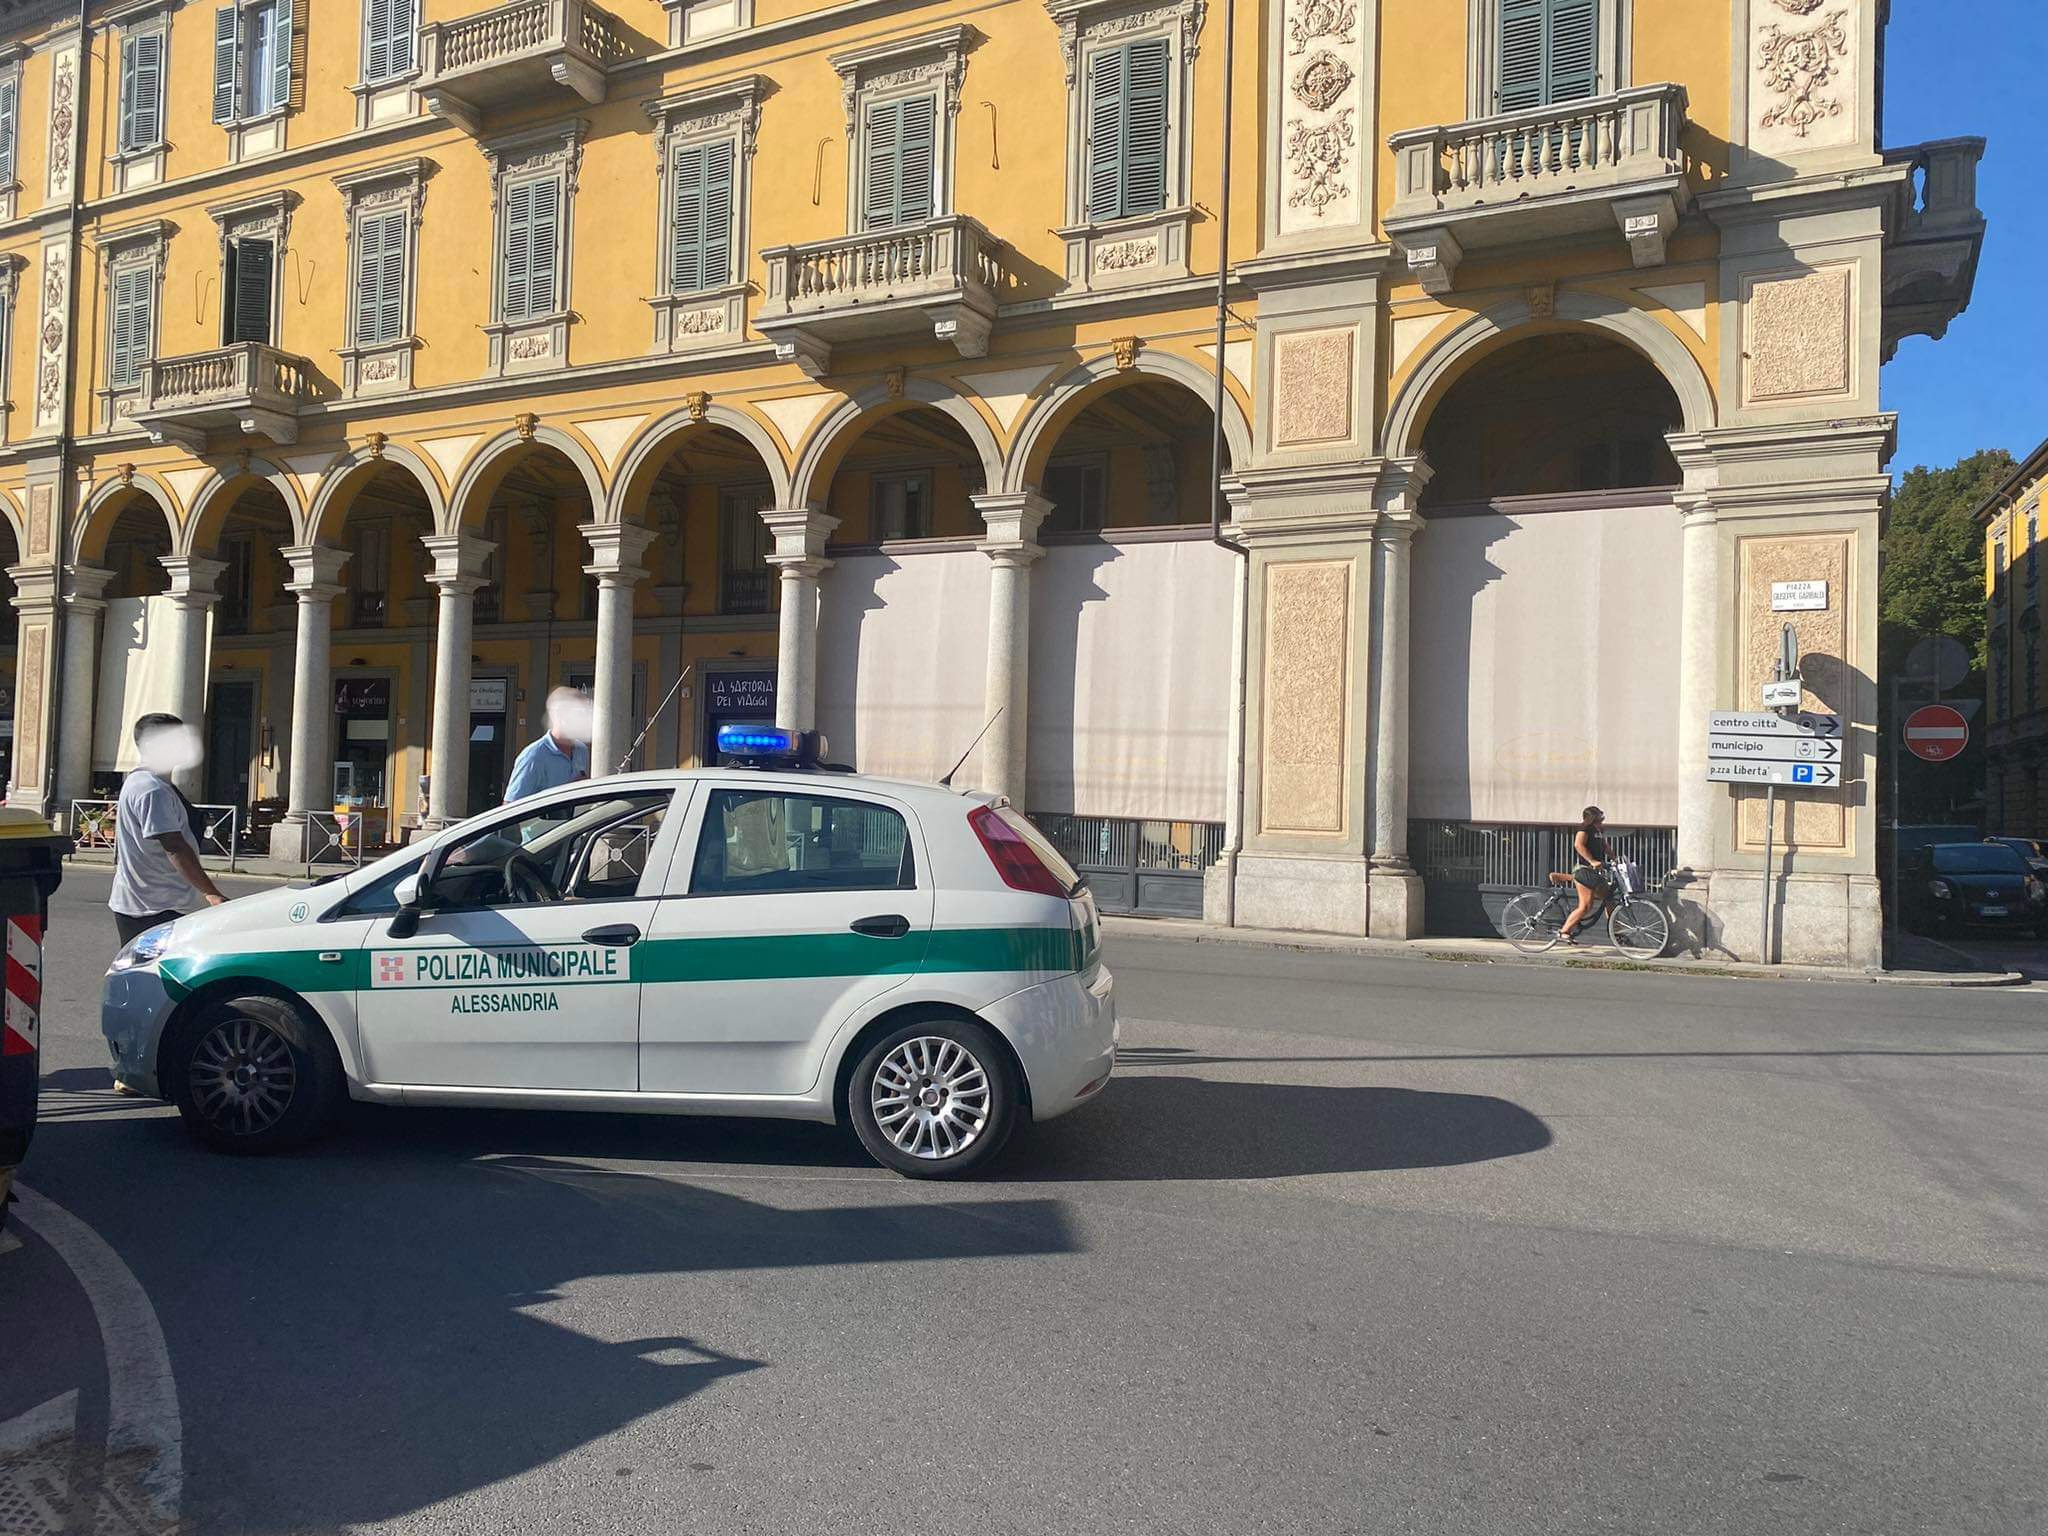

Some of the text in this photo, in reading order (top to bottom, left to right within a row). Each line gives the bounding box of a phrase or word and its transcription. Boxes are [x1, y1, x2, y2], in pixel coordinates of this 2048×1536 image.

[712, 680, 773, 693] LA SARTORIA
[716, 694, 768, 707] DEI VIAGGI
[1713, 719, 1749, 728] centro
[1711, 742, 1764, 752] municipio
[1710, 767, 1730, 775] p.zza
[1797, 768, 1808, 780] P
[292, 905, 306, 919] 40
[417, 949, 617, 980] POLIZIA MUNICIPALE
[451, 992, 559, 1013] ALESSANDRIA
